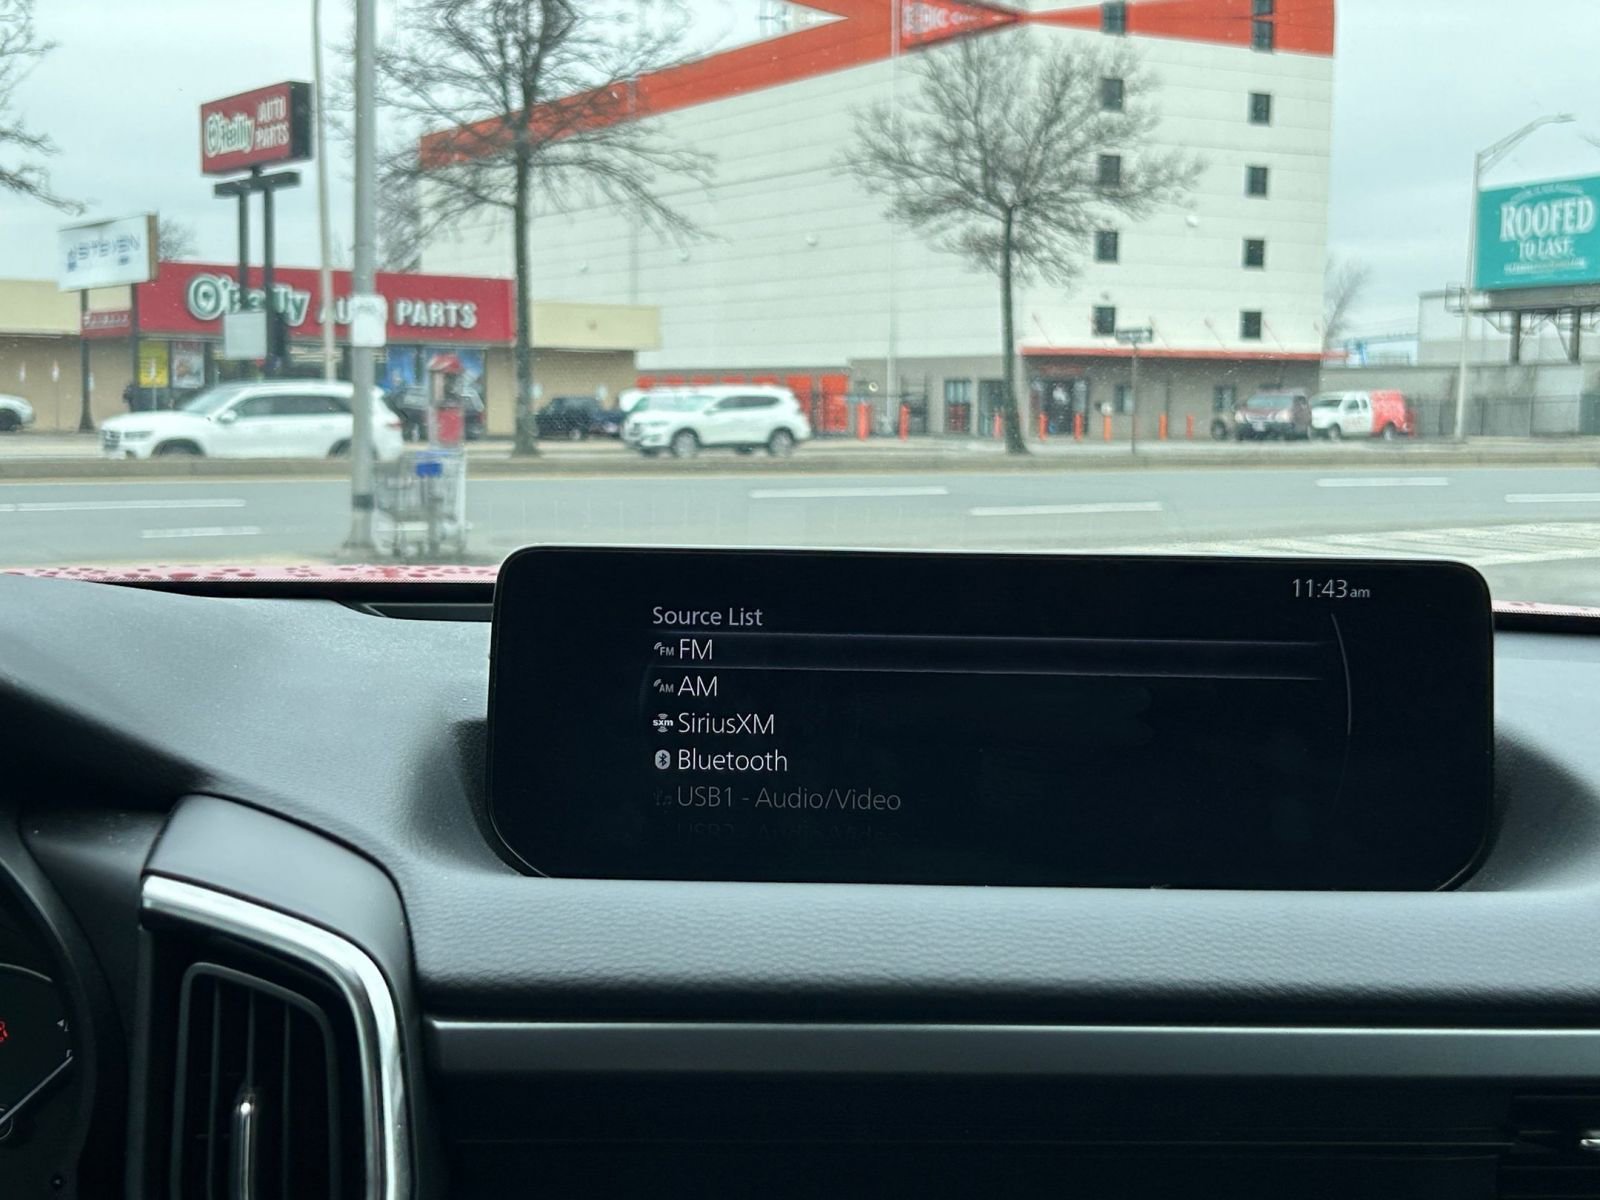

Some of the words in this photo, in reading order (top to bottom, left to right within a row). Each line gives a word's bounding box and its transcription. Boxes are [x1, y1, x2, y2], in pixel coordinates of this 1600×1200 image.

[257, 96, 286, 123] AUTO
[256, 121, 290, 149] PARTS
[1500, 196, 1594, 242] ROOFED
[1518, 239, 1535, 261] TO
[396, 298, 478, 329] PARTS
[1292, 578, 1348, 598] 11:43
[1349, 588, 1371, 598] am
[652, 606, 722, 625] Source
[729, 608, 763, 626] List
[659, 646, 675, 657] FM
[679, 639, 713, 660] FM
[659, 683, 674, 693] AM
[677, 676, 718, 697] AM
[677, 713, 775, 735] SiriusXM
[677, 748, 788, 772] Bluetooth
[677, 786, 733, 808] USB1
[754, 786, 901, 811] Audio/Video
